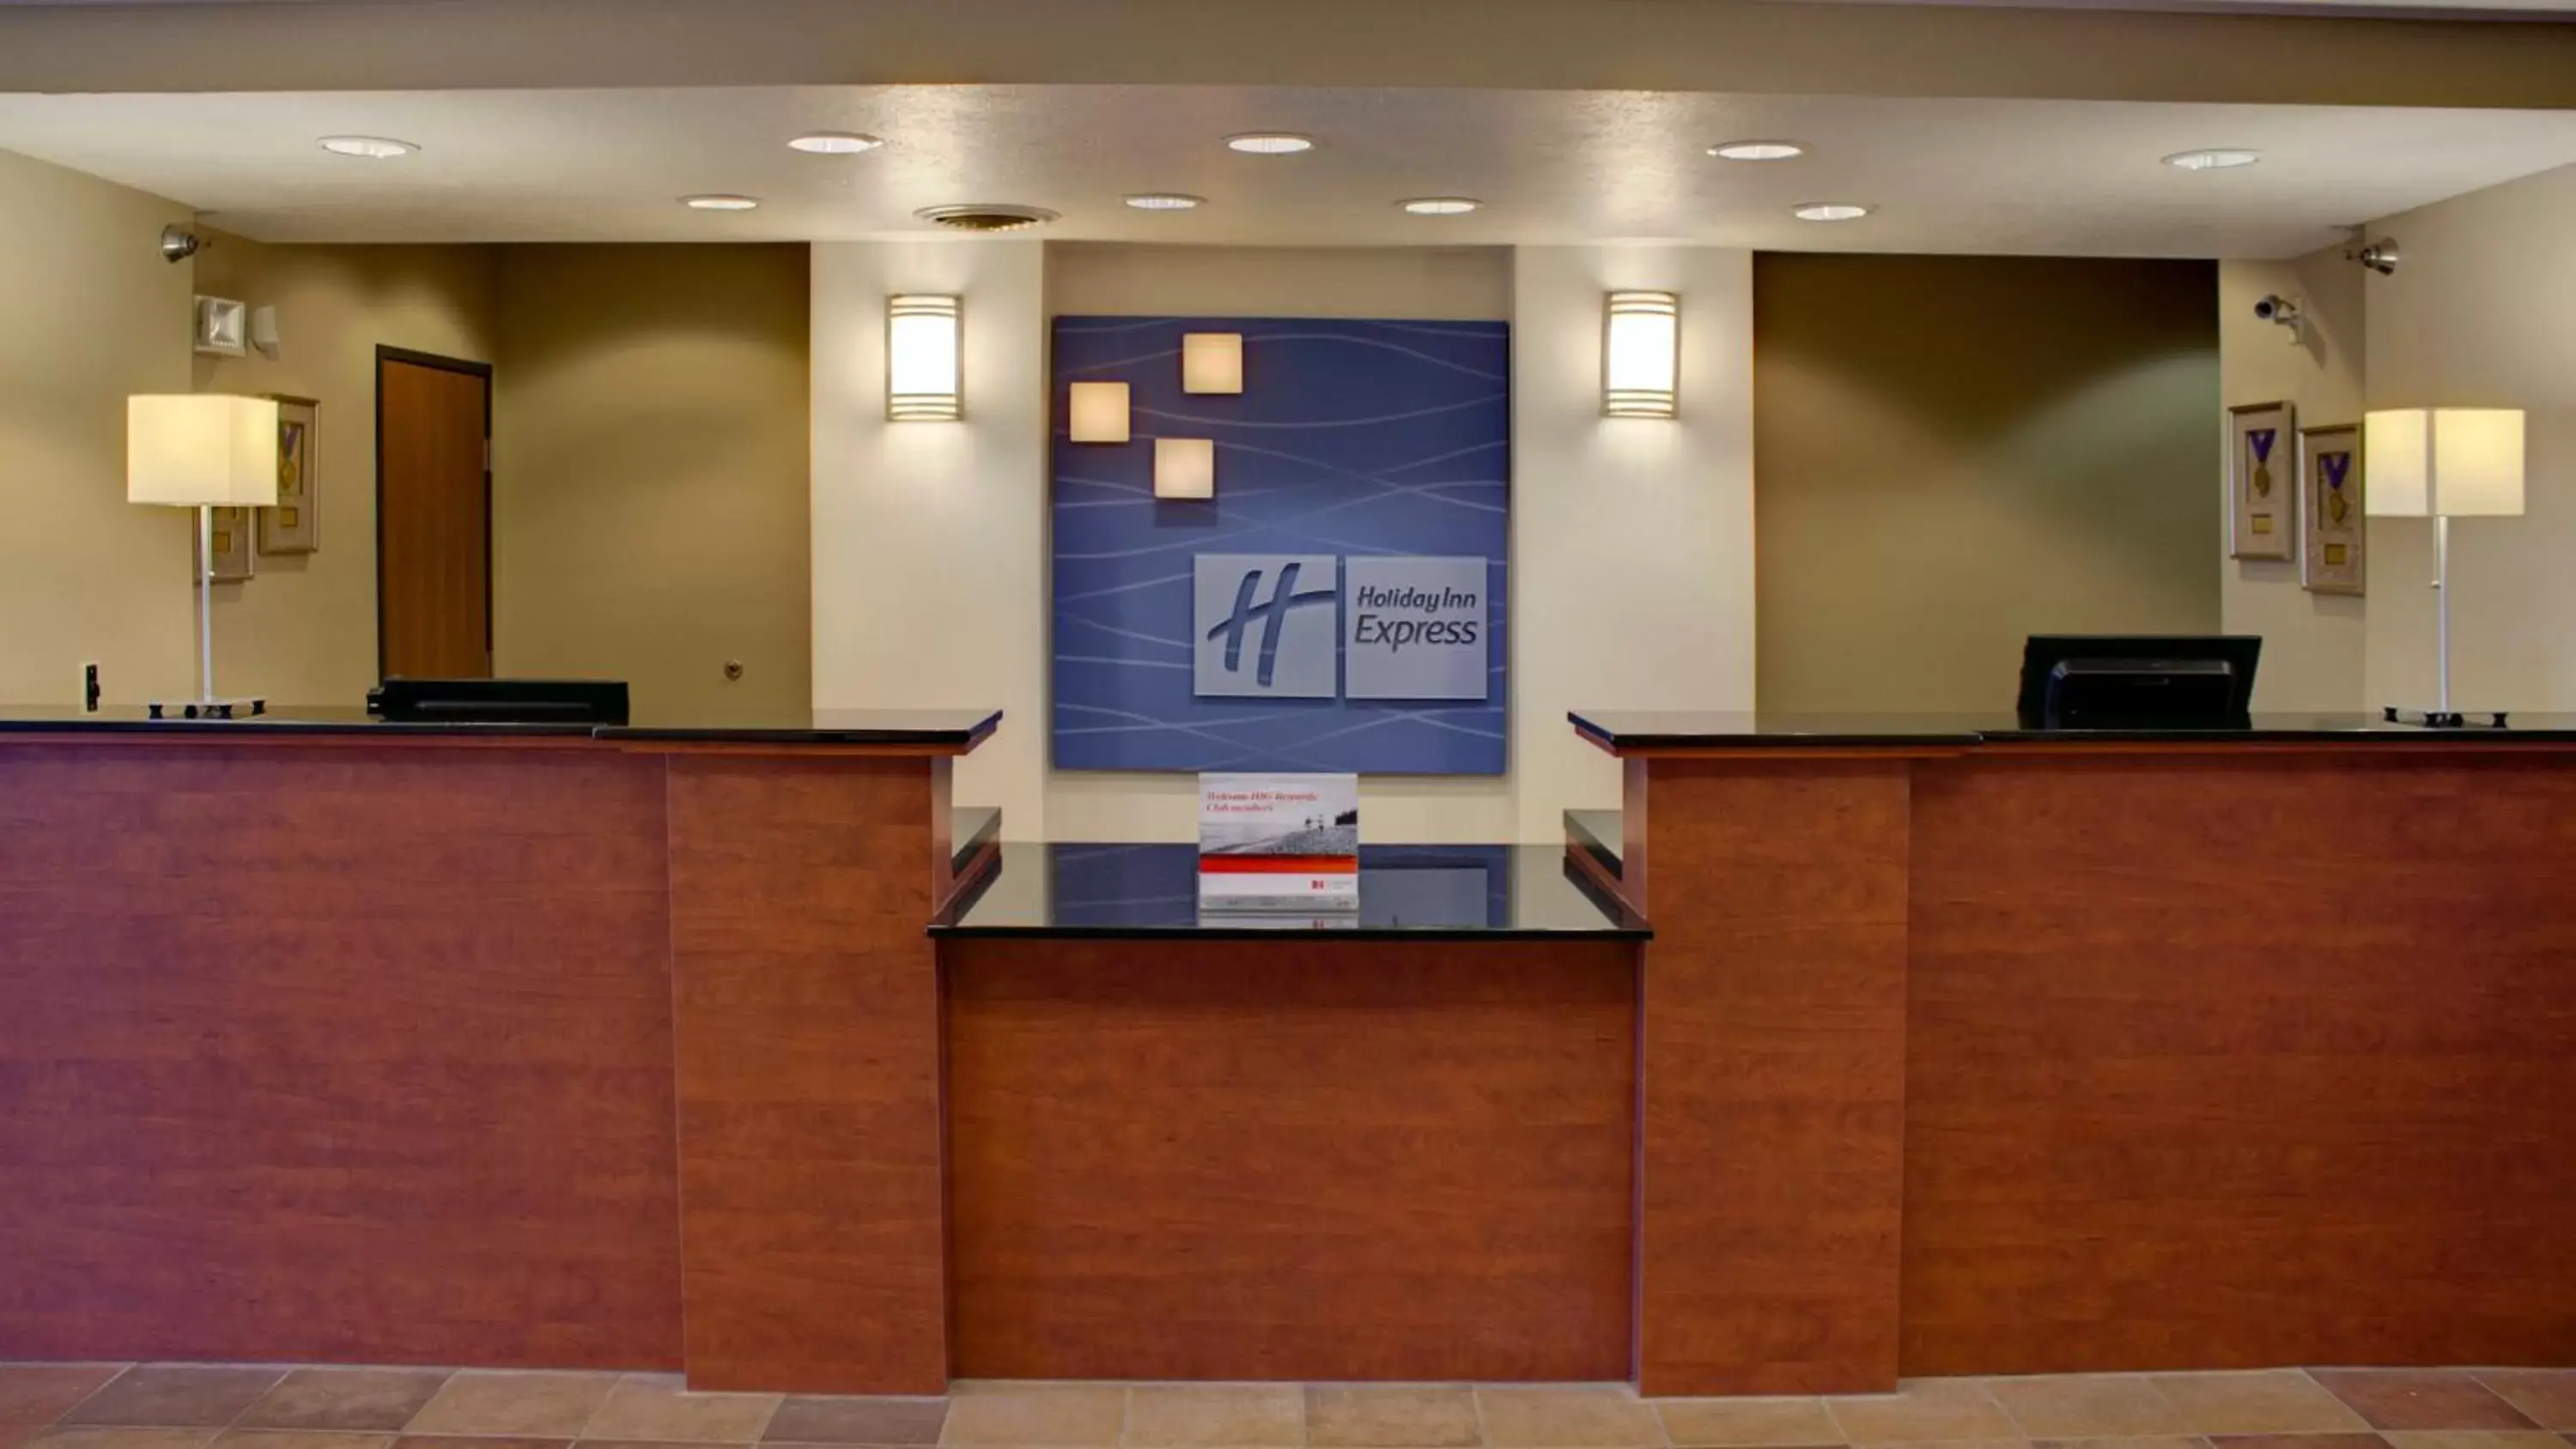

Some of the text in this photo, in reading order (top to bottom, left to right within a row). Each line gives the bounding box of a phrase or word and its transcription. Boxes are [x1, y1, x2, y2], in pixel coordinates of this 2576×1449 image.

[1358, 585, 1476, 612] Holiday Inn
[1354, 615, 1478, 652] Express
